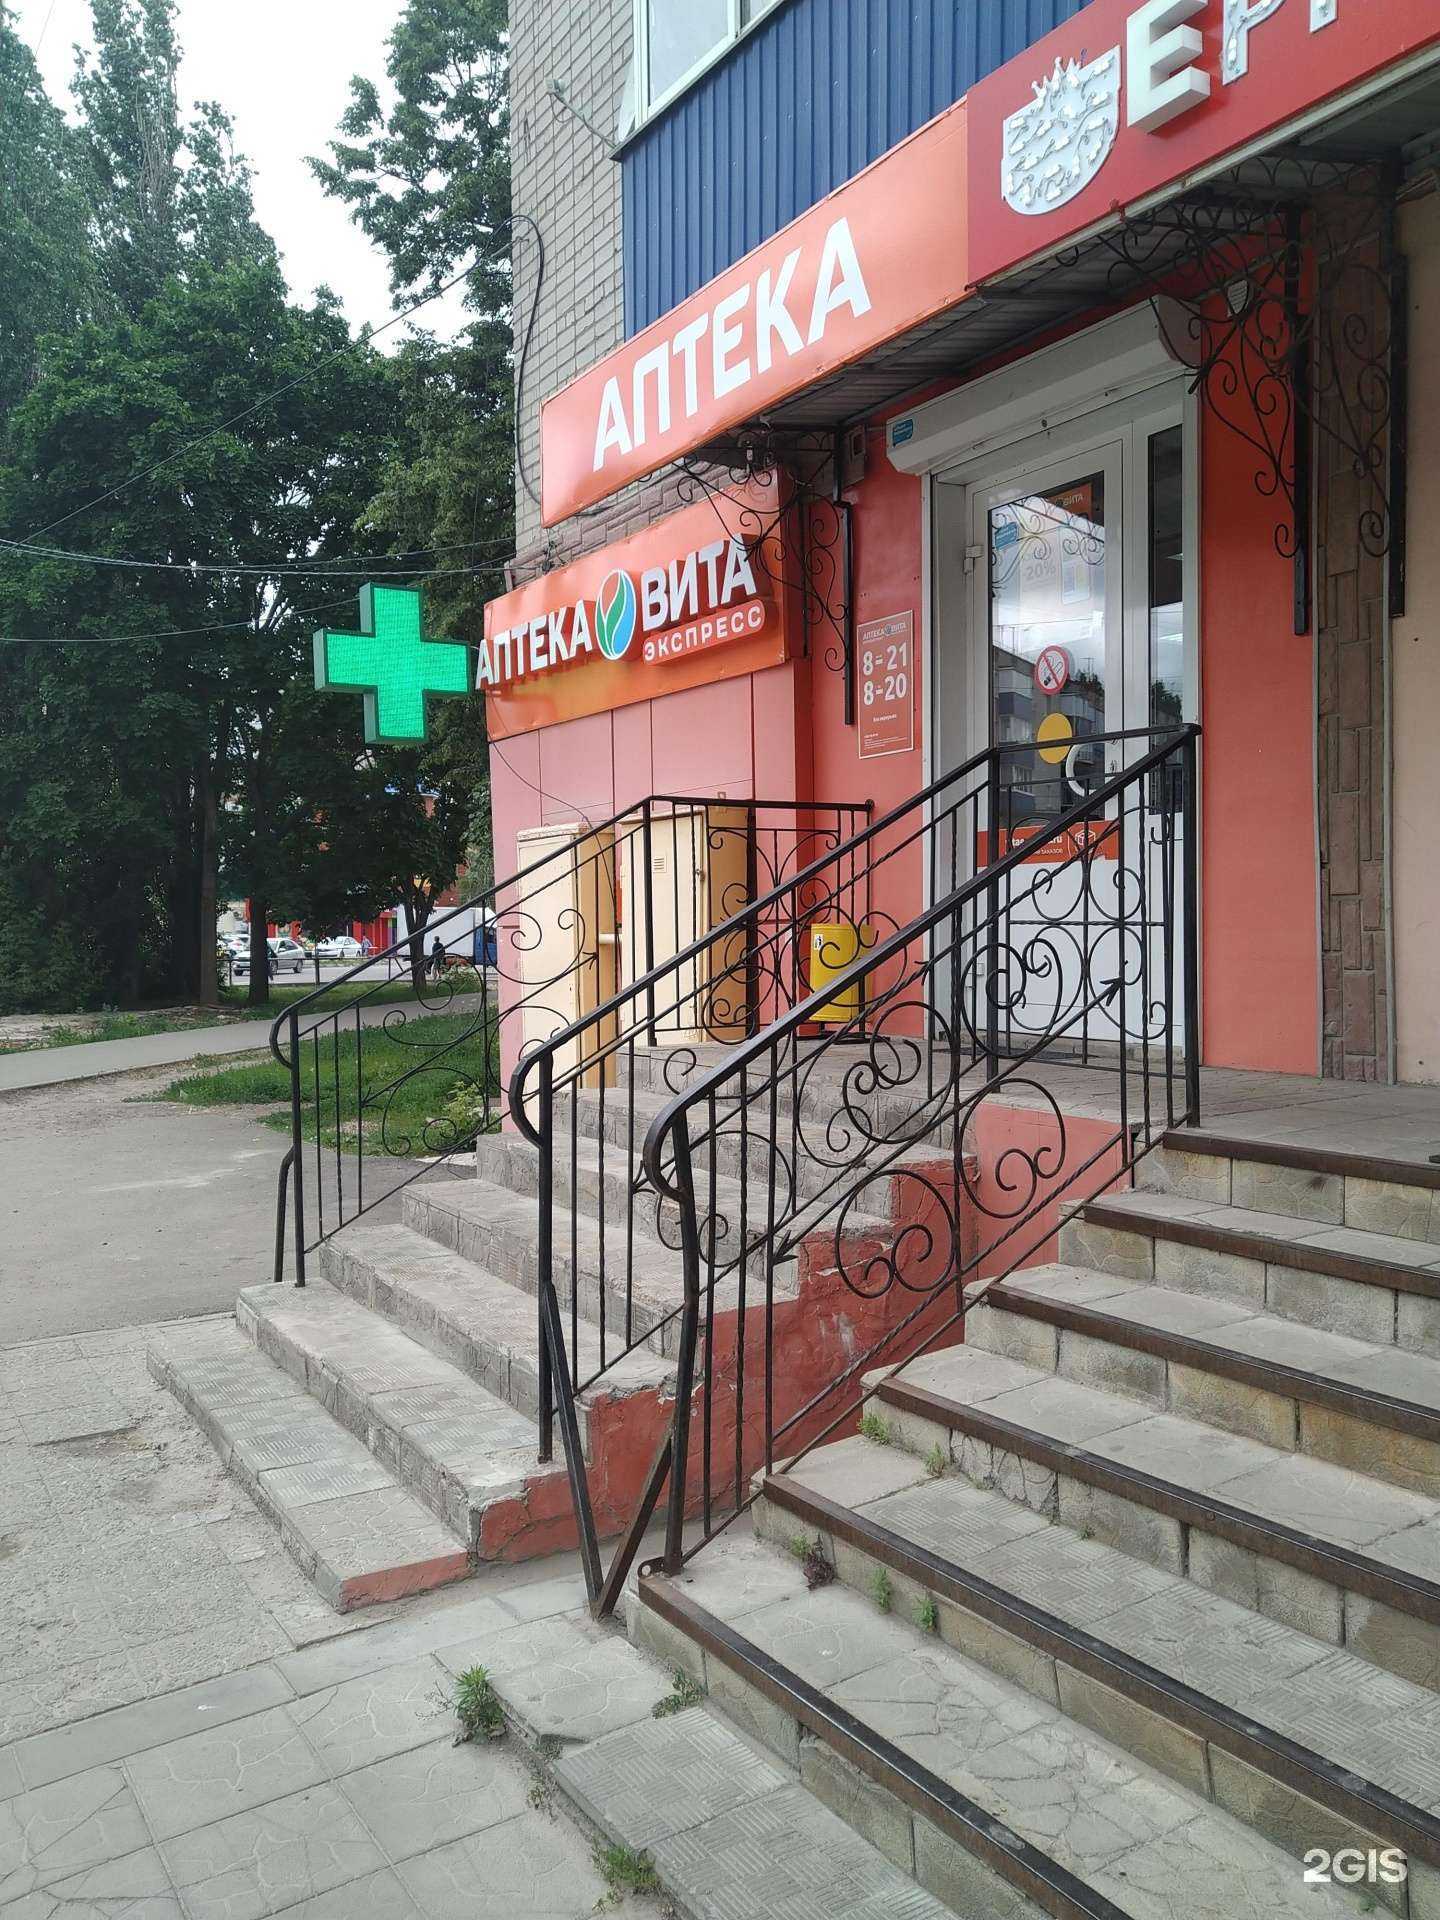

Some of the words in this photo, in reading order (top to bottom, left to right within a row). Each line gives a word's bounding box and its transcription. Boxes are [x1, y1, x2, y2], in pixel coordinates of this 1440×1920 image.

[593, 216, 872, 472] АПТЕКА
[475, 599, 592, 690] АПТЕКА
[641, 532, 757, 632] ВИТА
[644, 606, 762, 662] ЭКСПРЕСС
